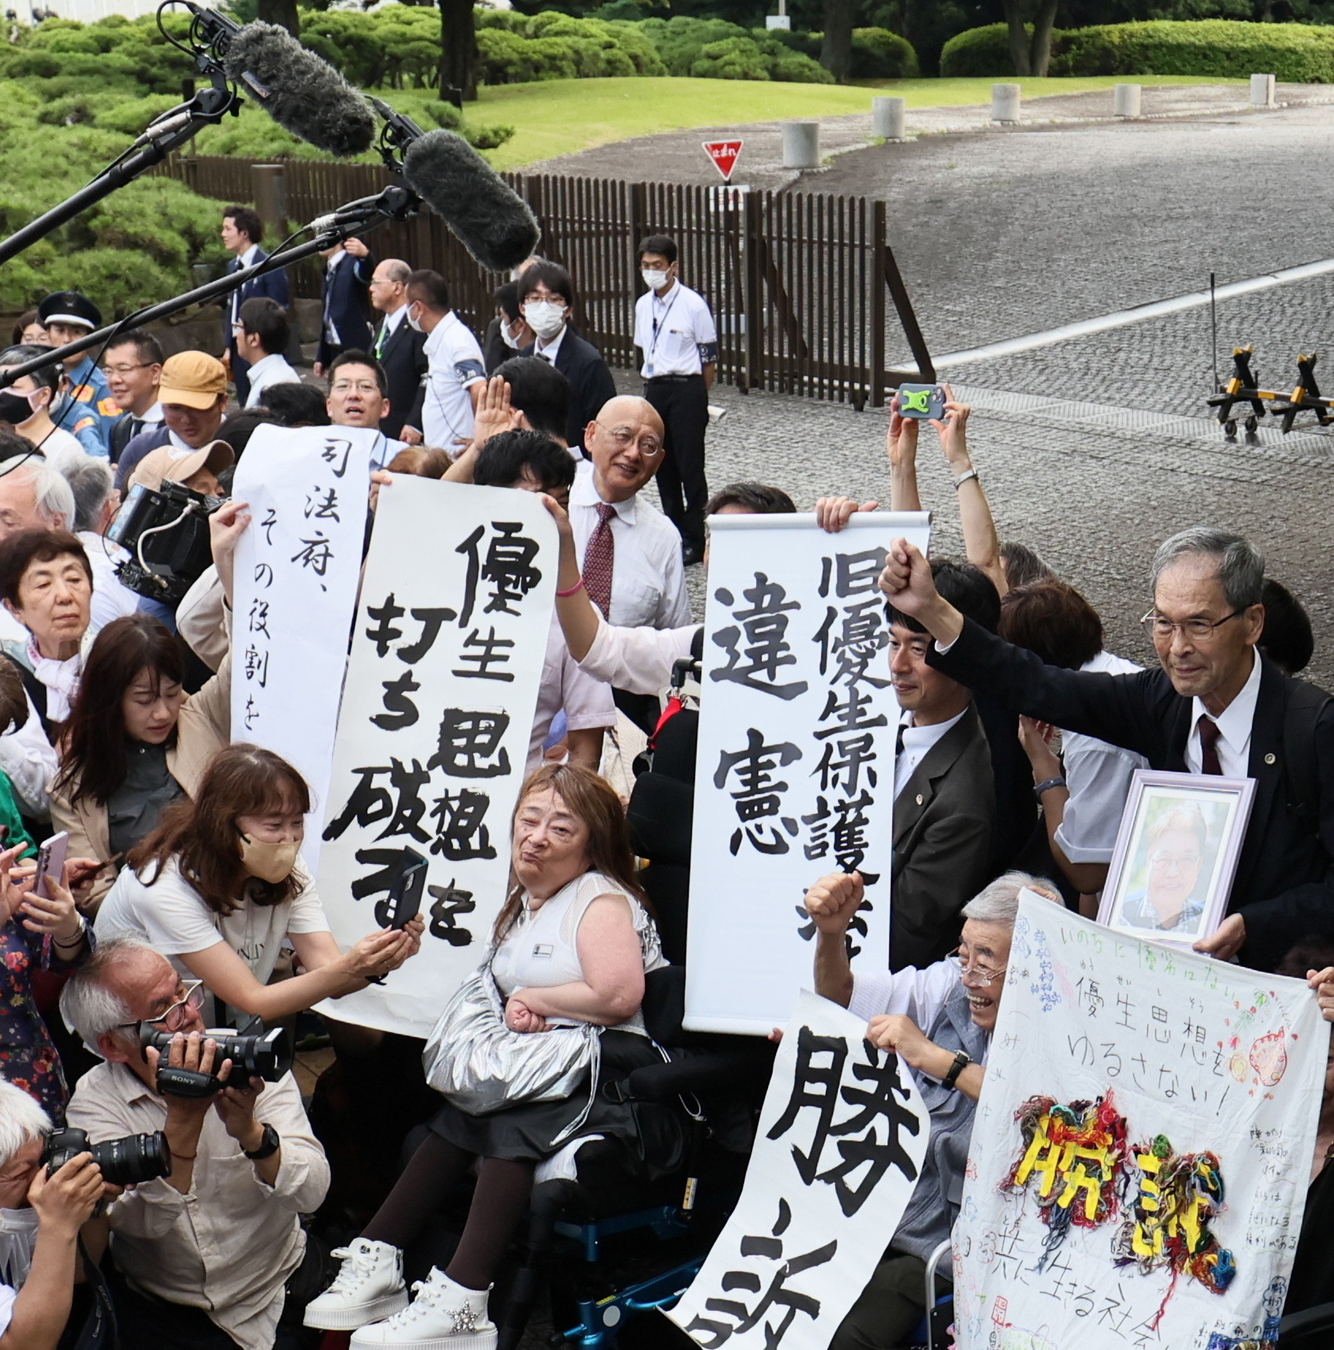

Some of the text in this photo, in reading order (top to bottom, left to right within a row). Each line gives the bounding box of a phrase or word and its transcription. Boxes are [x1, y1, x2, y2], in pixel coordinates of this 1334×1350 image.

[244, 508, 278, 731] その役割を
[709, 571, 809, 857] 違憲
[427, 521, 543, 946] 優生思想を
[171, 1075, 196, 1085] SONY
[1076, 976, 1225, 1077] 優生思想を
